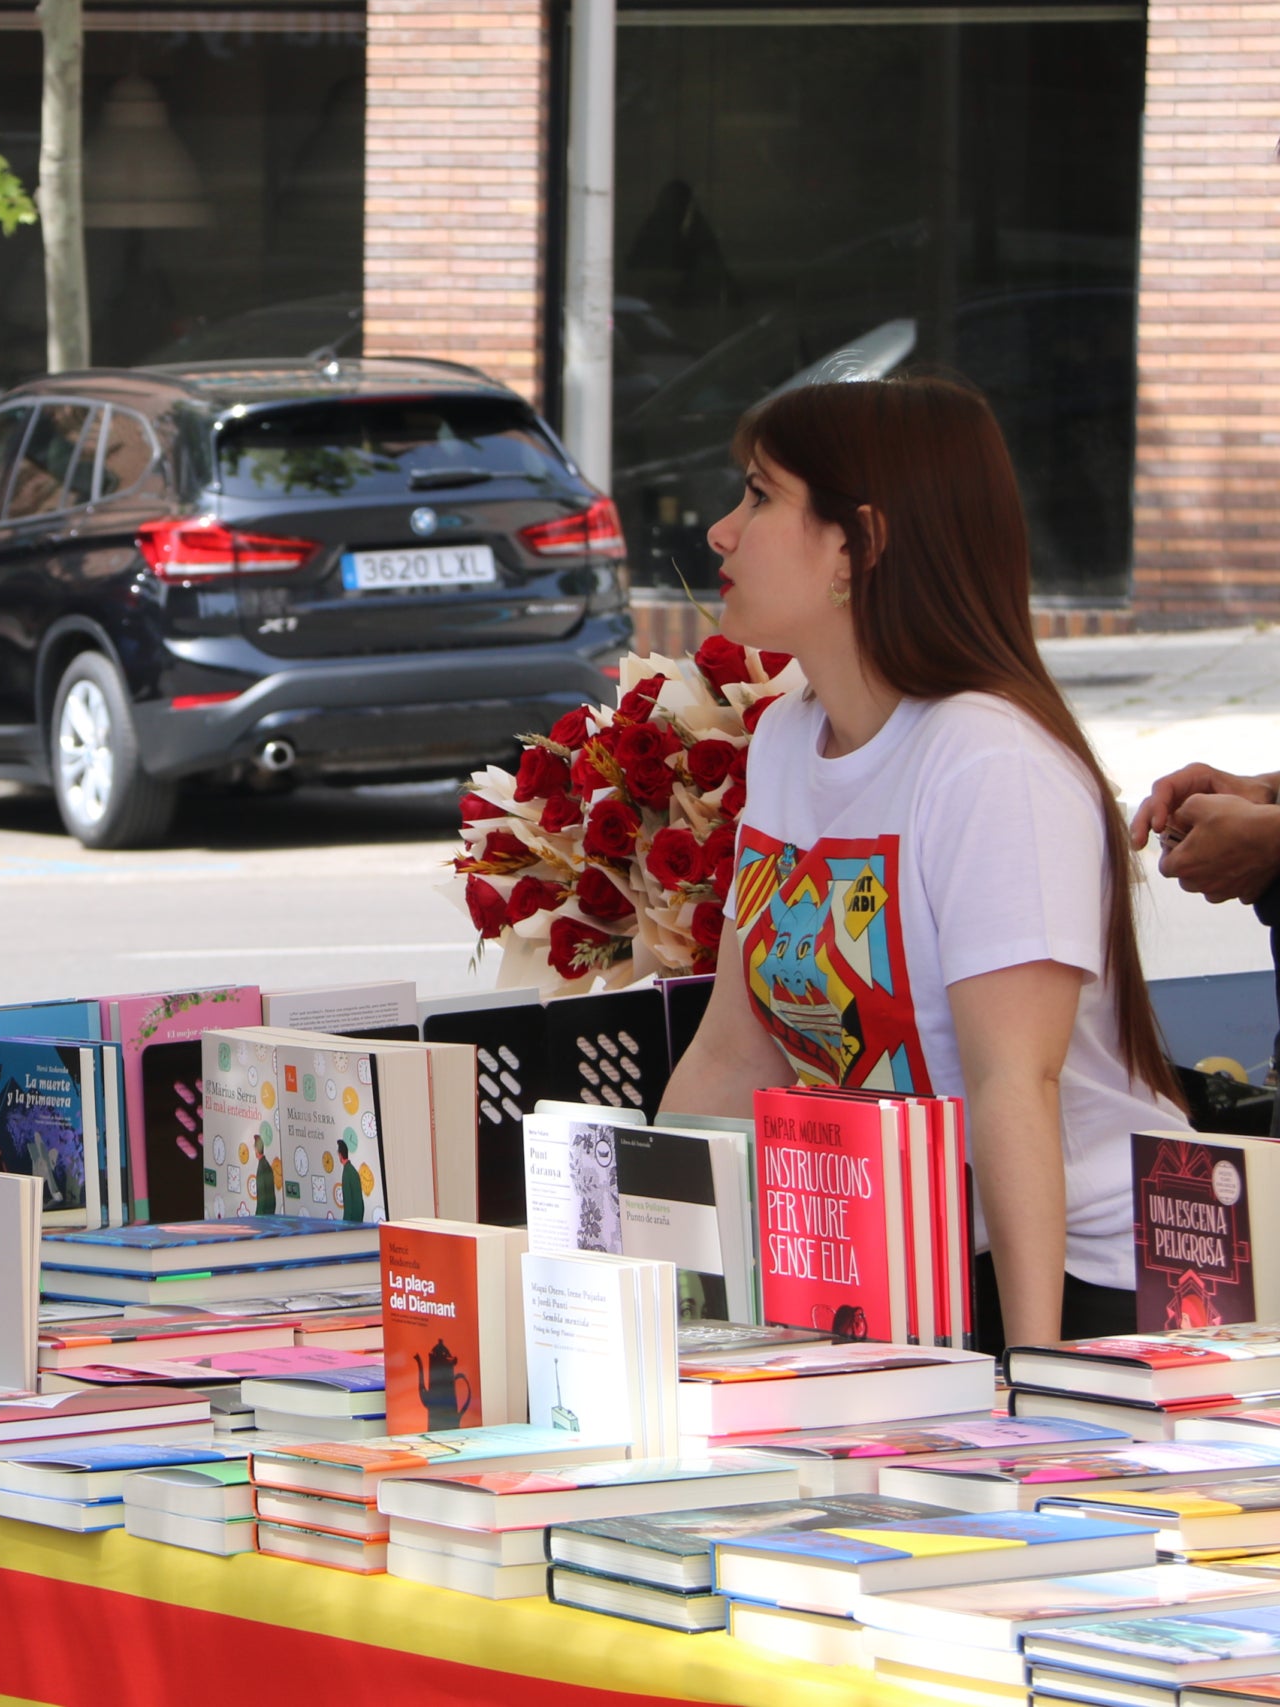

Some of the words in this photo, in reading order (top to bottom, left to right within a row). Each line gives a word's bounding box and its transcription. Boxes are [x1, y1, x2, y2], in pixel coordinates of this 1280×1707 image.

[363, 555, 430, 582] 3620
[436, 552, 488, 578] LXL
[25, 1073, 37, 1089] La
[39, 1079, 71, 1092] muerte
[237, 1087, 257, 1104] Serra
[7, 1092, 13, 1107] y
[15, 1089, 25, 1104] la
[26, 1091, 71, 1109] primavera
[205, 1095, 212, 1110] El
[213, 1100, 226, 1113] mal
[228, 1104, 262, 1120] entendido
[288, 1124, 295, 1136] El
[295, 1126, 307, 1138] mal
[764, 1115, 796, 1142] EMPAR
[799, 1120, 842, 1147] MOLINER
[530, 1147, 547, 1160] Punt
[764, 1146, 872, 1199] INSTRUCCIONS
[626, 1211, 645, 1222] Punto
[646, 1213, 653, 1224] de
[653, 1215, 670, 1226] araña
[767, 1190, 799, 1234] PER
[801, 1194, 851, 1240] VIURE
[1149, 1194, 1175, 1227] UNA
[1175, 1199, 1228, 1235] ESCENA
[768, 1233, 818, 1280] SENSE
[821, 1241, 860, 1286] ELLA
[1154, 1228, 1227, 1268] PELIGROSA
[389, 1270, 403, 1289] La
[405, 1274, 435, 1297] plaça
[390, 1292, 407, 1310] del
[408, 1294, 456, 1318] Diamant
[542, 1311, 563, 1324] Sembla
